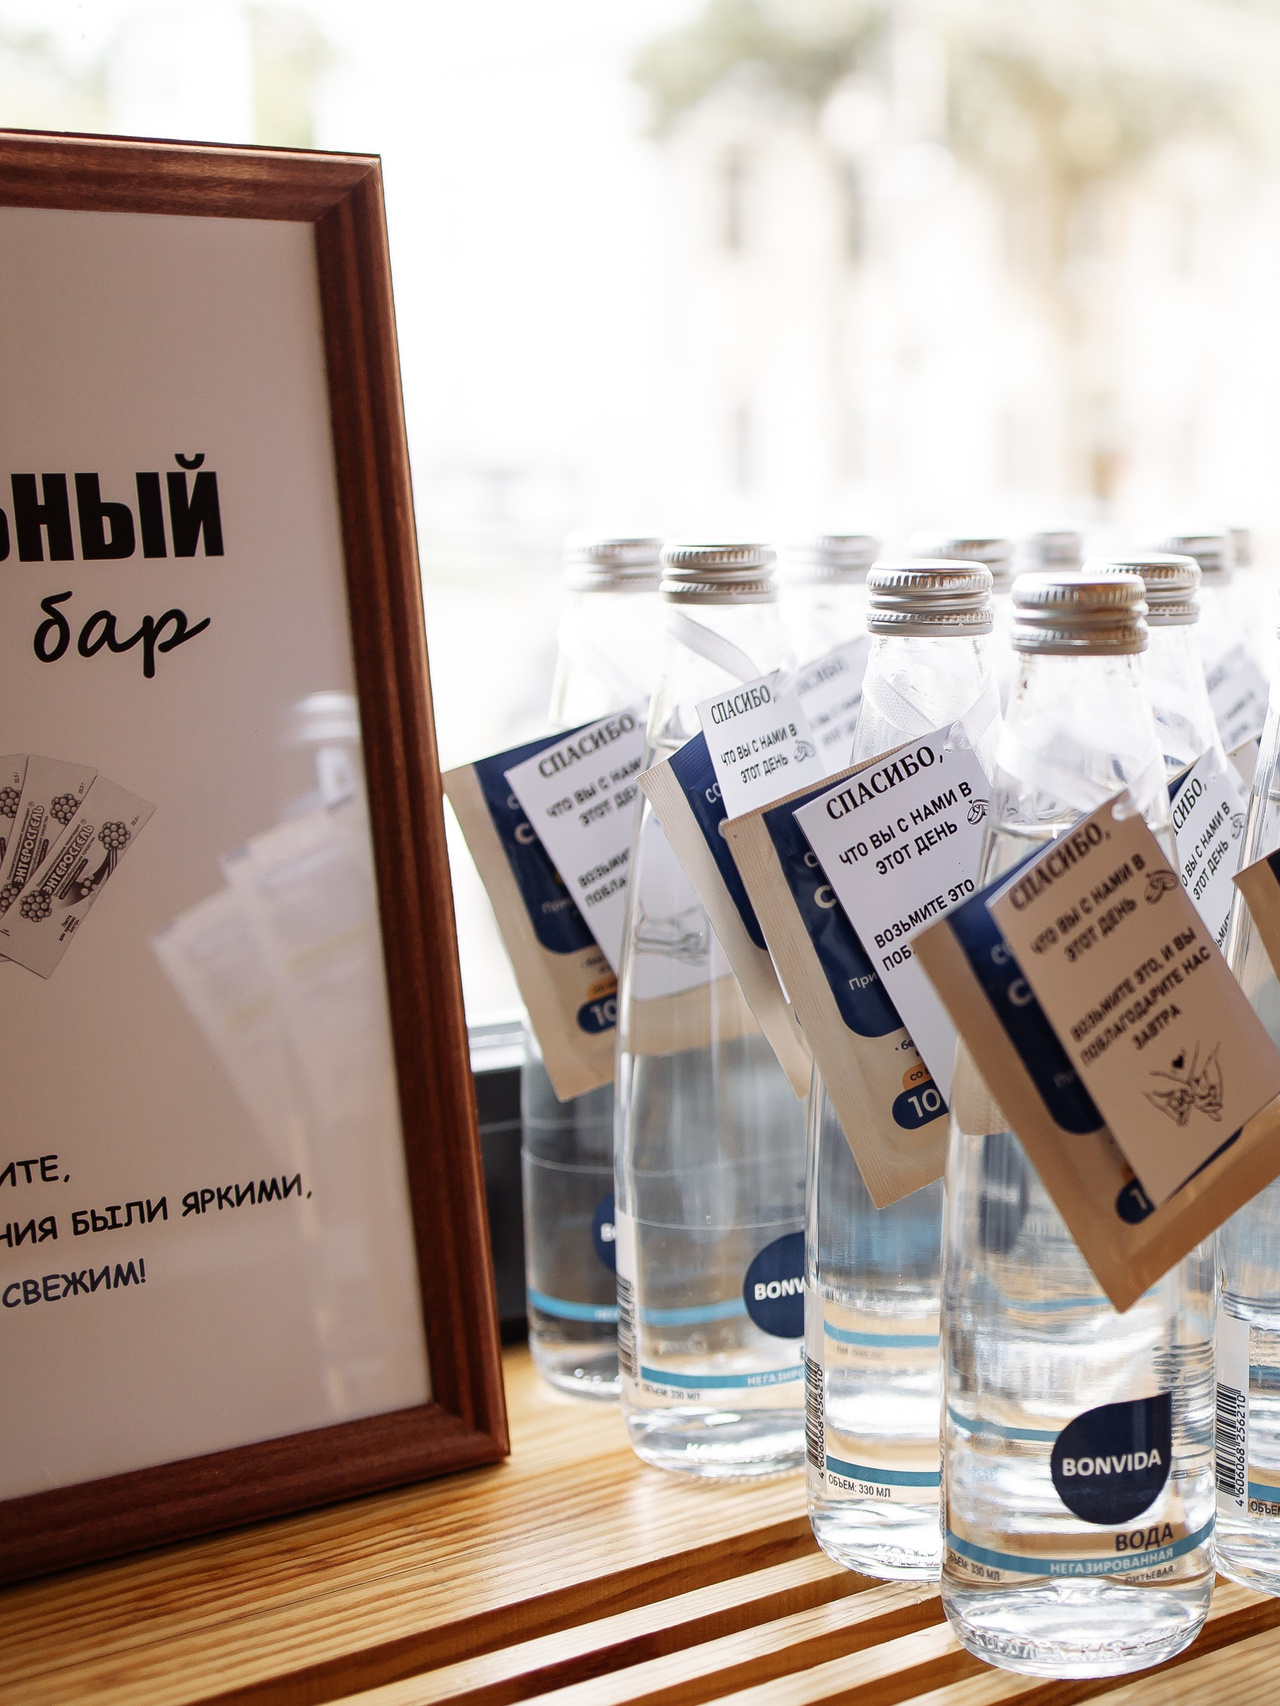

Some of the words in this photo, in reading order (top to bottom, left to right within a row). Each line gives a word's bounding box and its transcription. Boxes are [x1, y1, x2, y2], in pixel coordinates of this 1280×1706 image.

[0, 453, 225, 562] НЫЙ
[33, 590, 212, 679] бар
[711, 685, 776, 724] СПАСИБО,
[721, 750, 736, 766] ЧТО
[736, 743, 751, 760] ВЫ
[752, 740, 758, 753] С
[760, 728, 787, 750] НАМИ
[788, 723, 797, 737] В
[740, 764, 761, 784] ЭТОТ
[763, 753, 788, 776] ДЕНЬ
[826, 746, 943, 820] СПАСИБО,
[1173, 777, 1207, 837] СИБО,
[14, 805, 45, 884] ЭНТЕРОСГЕЛЬ
[839, 842, 868, 865] ЧТО
[869, 825, 896, 850] ВЫ
[897, 818, 909, 832] С
[910, 789, 958, 825] НАМИ
[958, 782, 972, 797] В
[876, 844, 912, 875] ЭТОТ
[914, 821, 958, 855] ДЕНЬ
[1185, 854, 1198, 878] ВЫ
[1195, 845, 1203, 858] С
[1200, 810, 1224, 846] НАМИ
[1221, 801, 1231, 815] В
[42, 824, 95, 895] ЭНТЕРОСГЕЛЬ
[1008, 822, 1111, 912] СПАСИБО,
[1193, 868, 1211, 901] ЭТОТ
[1207, 840, 1229, 876] ДЕНЬ
[874, 895, 947, 949] ВОЗЬМИТЕ
[1030, 926, 1059, 955] ЧТО
[1055, 906, 1081, 935] ВЫ
[1079, 897, 1093, 915] С
[1090, 862, 1133, 905] НАМИ
[1131, 853, 1145, 872] В
[1064, 925, 1098, 963] ЭТОТ
[1098, 899, 1138, 938] ДЕНЬ
[1070, 978, 1136, 1042] ВОЗЬМИТЕ
[1173, 926, 1197, 952] ВЫ
[1181, 945, 1211, 976] НАС
[1132, 1003, 1182, 1050] ЗАВТРА
[908, 1088, 941, 1118] 10
[71, 1196, 169, 1236] БЫЛИ
[182, 1172, 312, 1218] ЯРКИМИ,
[2, 1257, 146, 1308] СВЕЖИМ!
[1237, 1394, 1246, 1443] 256210
[828, 1474, 857, 1493] ОБЪЕМ:
[858, 1484, 874, 1495] 330
[876, 1487, 891, 1498] МЛ
[1062, 1448, 1162, 1477] BONVIDA
[1236, 1448, 1245, 1496] 606068
[1050, 1548, 1174, 1575] НЕГАЗИРОВАННАЯ
[1115, 1522, 1174, 1552] ВОДА
[971, 1563, 984, 1576] 330
[986, 1570, 1000, 1581] МЛ
